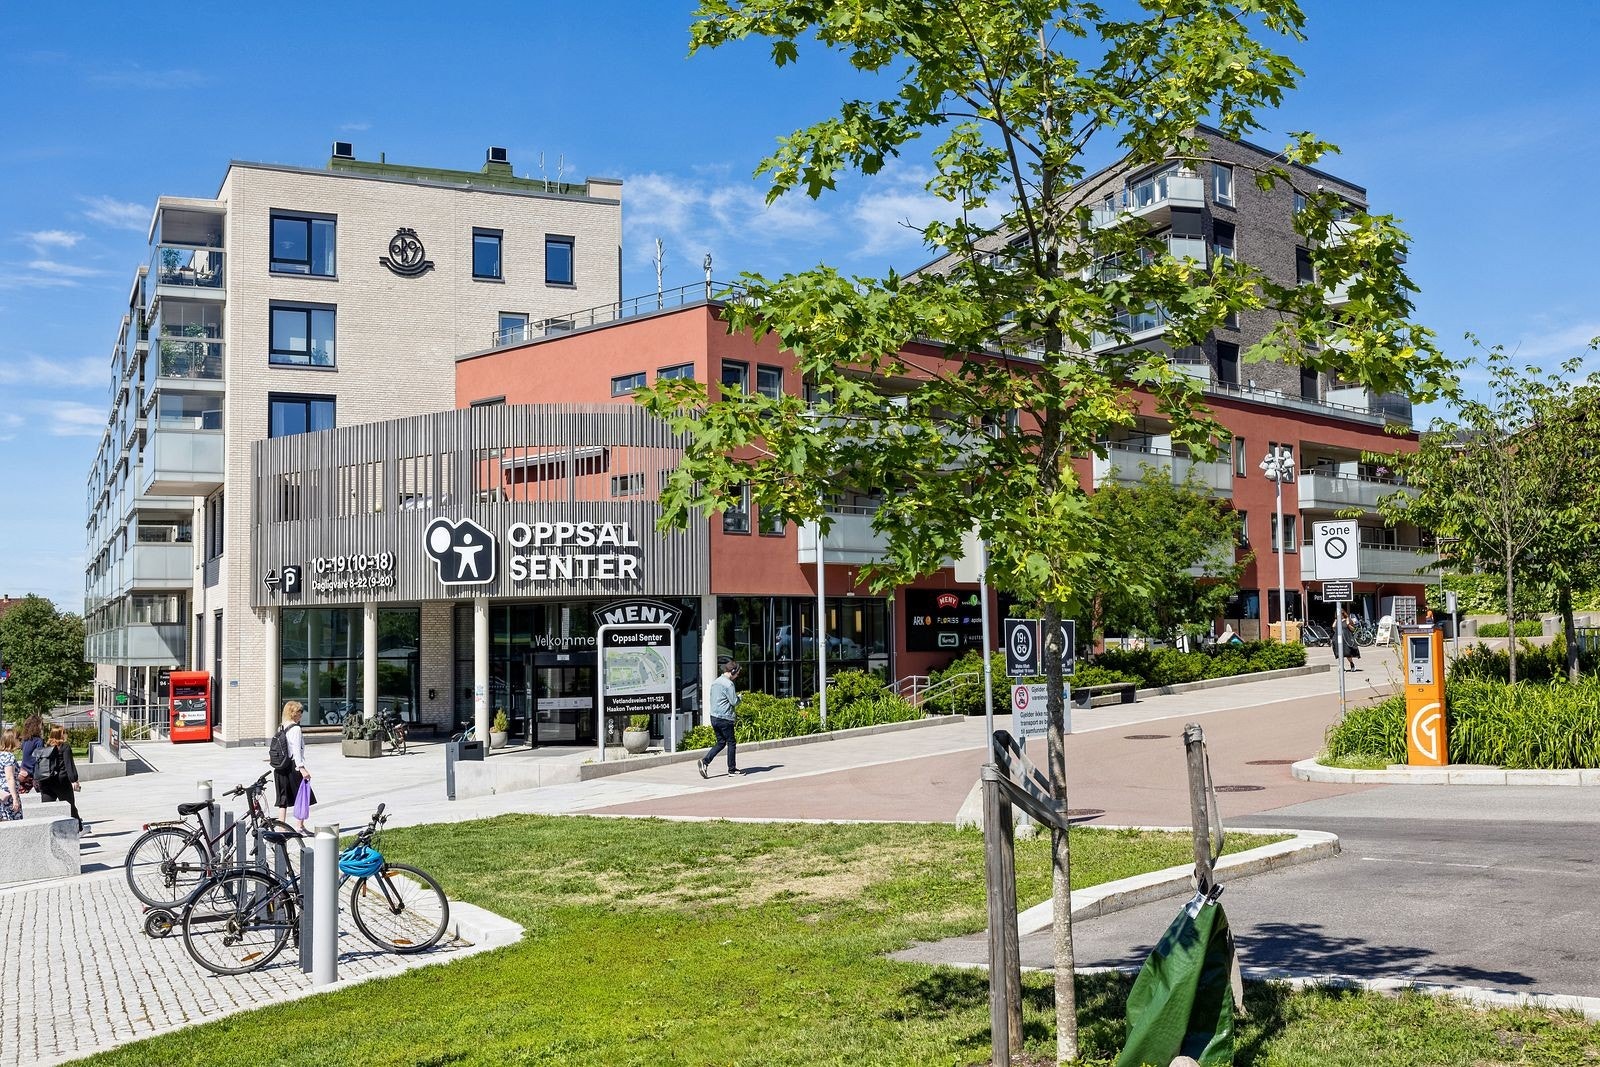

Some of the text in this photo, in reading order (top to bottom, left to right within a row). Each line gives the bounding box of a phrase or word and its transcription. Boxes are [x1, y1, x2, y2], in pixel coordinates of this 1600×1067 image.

[507, 521, 639, 548] OPPSAL
[1321, 525, 1350, 536] Sone
[509, 554, 638, 581] SENTER
[312, 580, 348, 592] Dagligvare
[940, 596, 956, 604] MENY
[604, 606, 672, 624] MENY
[913, 616, 924, 626] ARK
[612, 633, 662, 643] Oppsal Senter
[1016, 632, 1023, 643] 19
